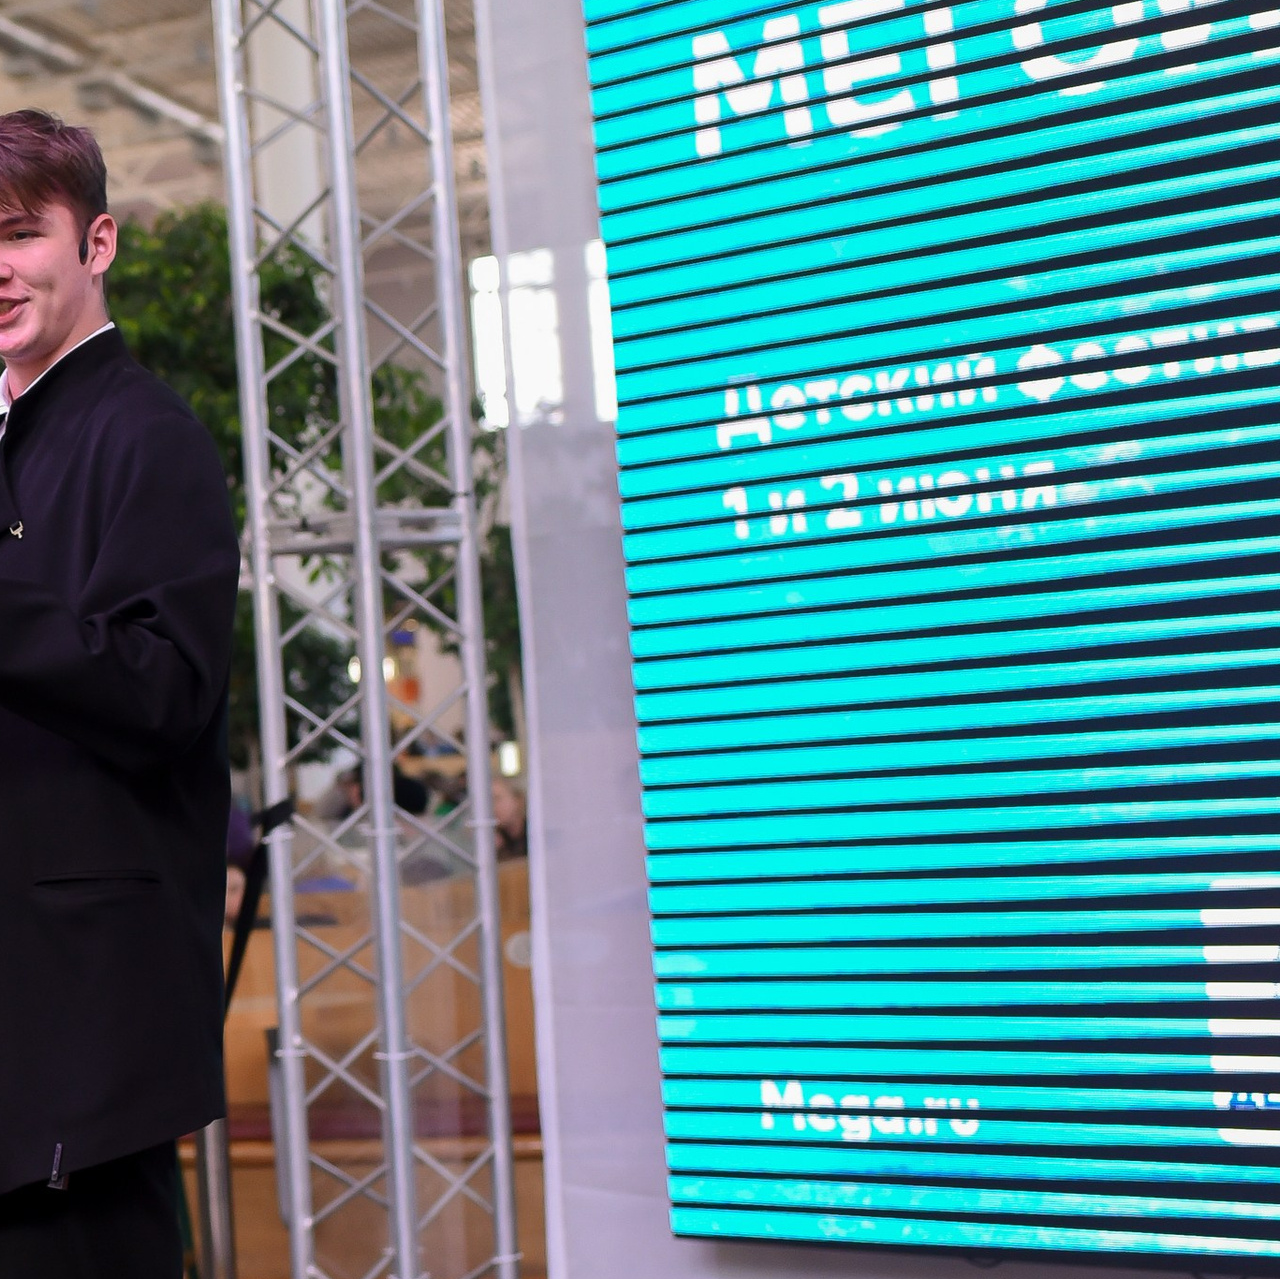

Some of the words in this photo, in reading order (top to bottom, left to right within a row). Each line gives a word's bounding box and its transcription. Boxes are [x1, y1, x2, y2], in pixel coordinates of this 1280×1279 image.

[715, 353, 997, 450] Детский
[723, 486, 749, 540] 1
[768, 488, 807, 536] и
[821, 472, 863, 528] 2
[877, 460, 1057, 525] июня
[760, 1079, 980, 1142] Mega.ru
